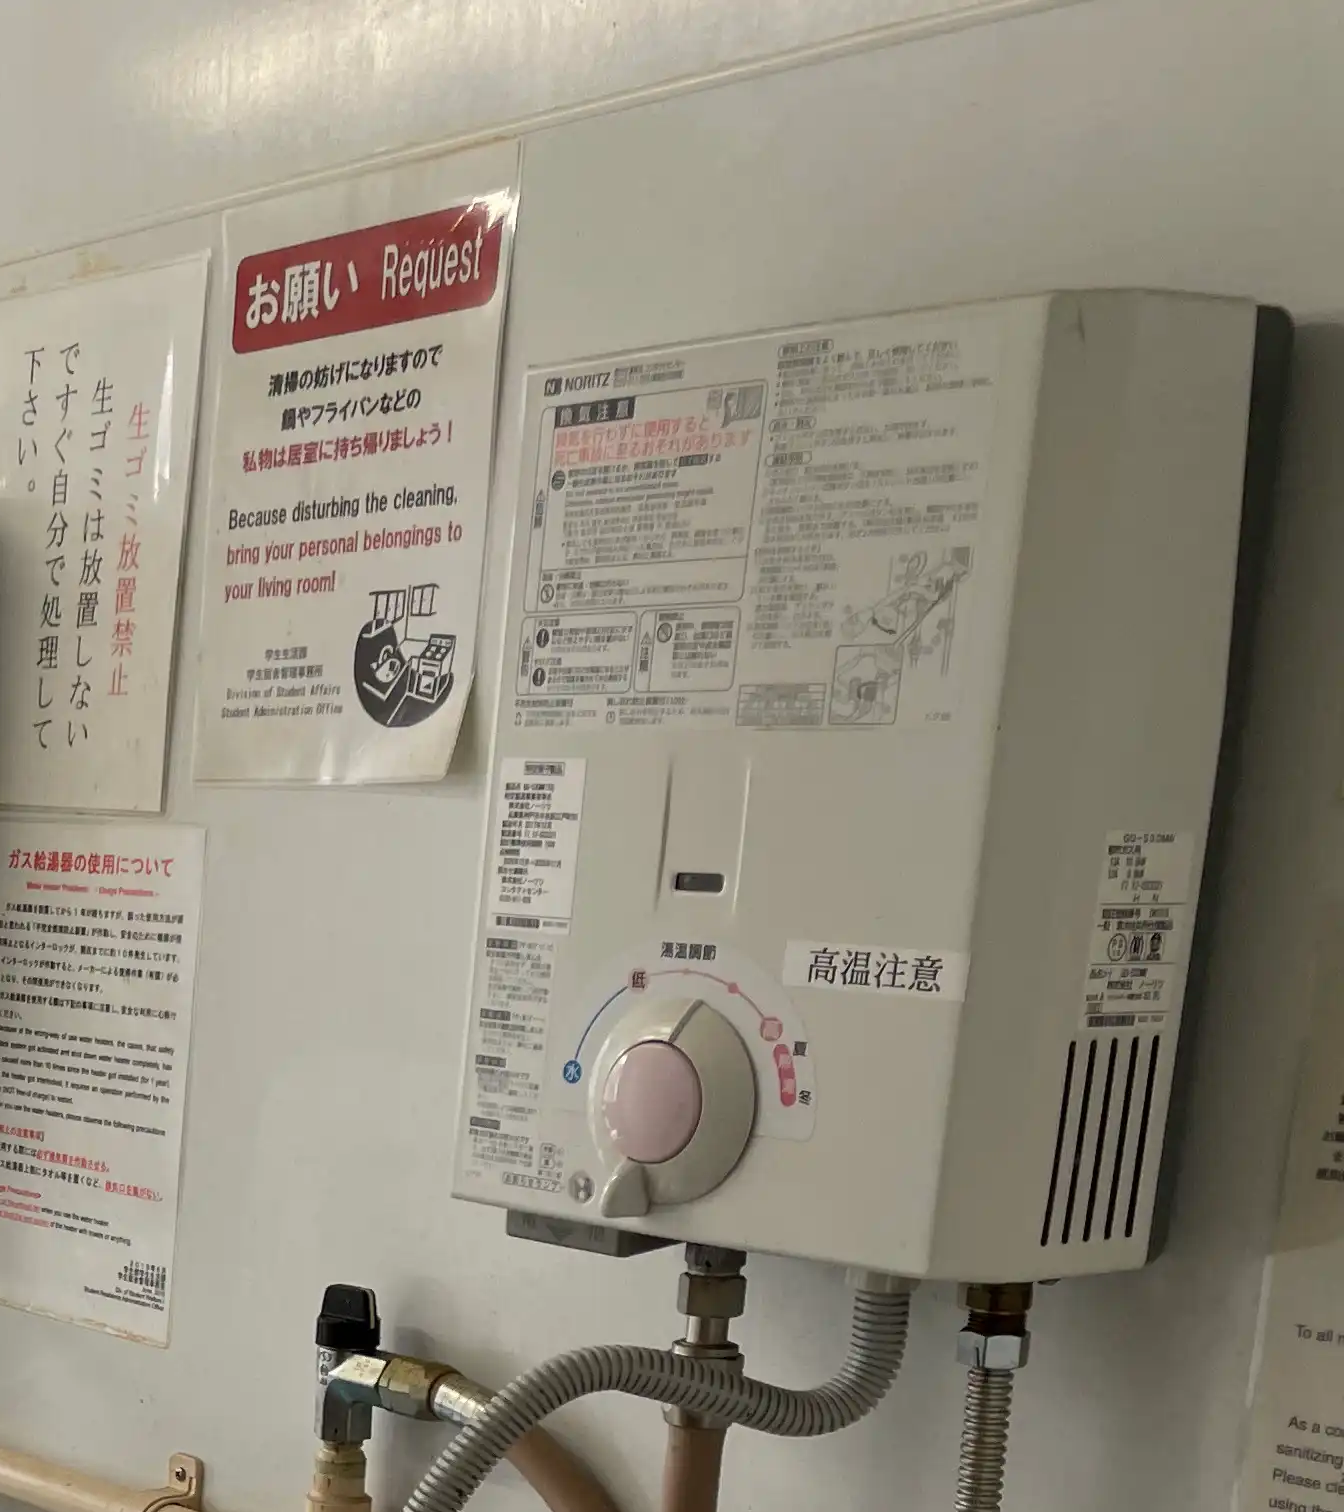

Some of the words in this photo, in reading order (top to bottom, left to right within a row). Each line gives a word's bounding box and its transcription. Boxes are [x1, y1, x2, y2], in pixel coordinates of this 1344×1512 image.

[245, 260, 359, 329] お願い
[380, 226, 484, 301] Request
[268, 344, 443, 397] 清掃の妨げになりますので
[564, 372, 611, 392] NORITZ
[16, 346, 46, 494] 下さい。
[228, 508, 287, 531] Because
[292, 498, 360, 523] disturbing
[365, 491, 388, 514] the
[393, 483, 459, 510] cleaning,
[32, 342, 80, 750] ですぐ自分で処理して
[66, 376, 114, 748] 生ゴミは放置しない
[107, 401, 150, 698] 生ゴミ放置禁止
[226, 544, 260, 566] bring
[264, 540, 295, 563] your
[298, 531, 359, 562] personal
[363, 524, 442, 552] belongings
[448, 521, 462, 543] to
[224, 579, 253, 603] your
[258, 575, 292, 600] living
[297, 570, 336, 595] room!
[806, 946, 944, 994] 高温注意
[566, 1063, 581, 1081] 水
[1294, 1323, 1312, 1340] To
[1316, 1329, 1334, 1345] all
[1288, 1415, 1308, 1431] As
[1312, 1423, 1320, 1434] a
[1272, 1467, 1321, 1491] Please
[1276, 1443, 1343, 1470] sanitizing
